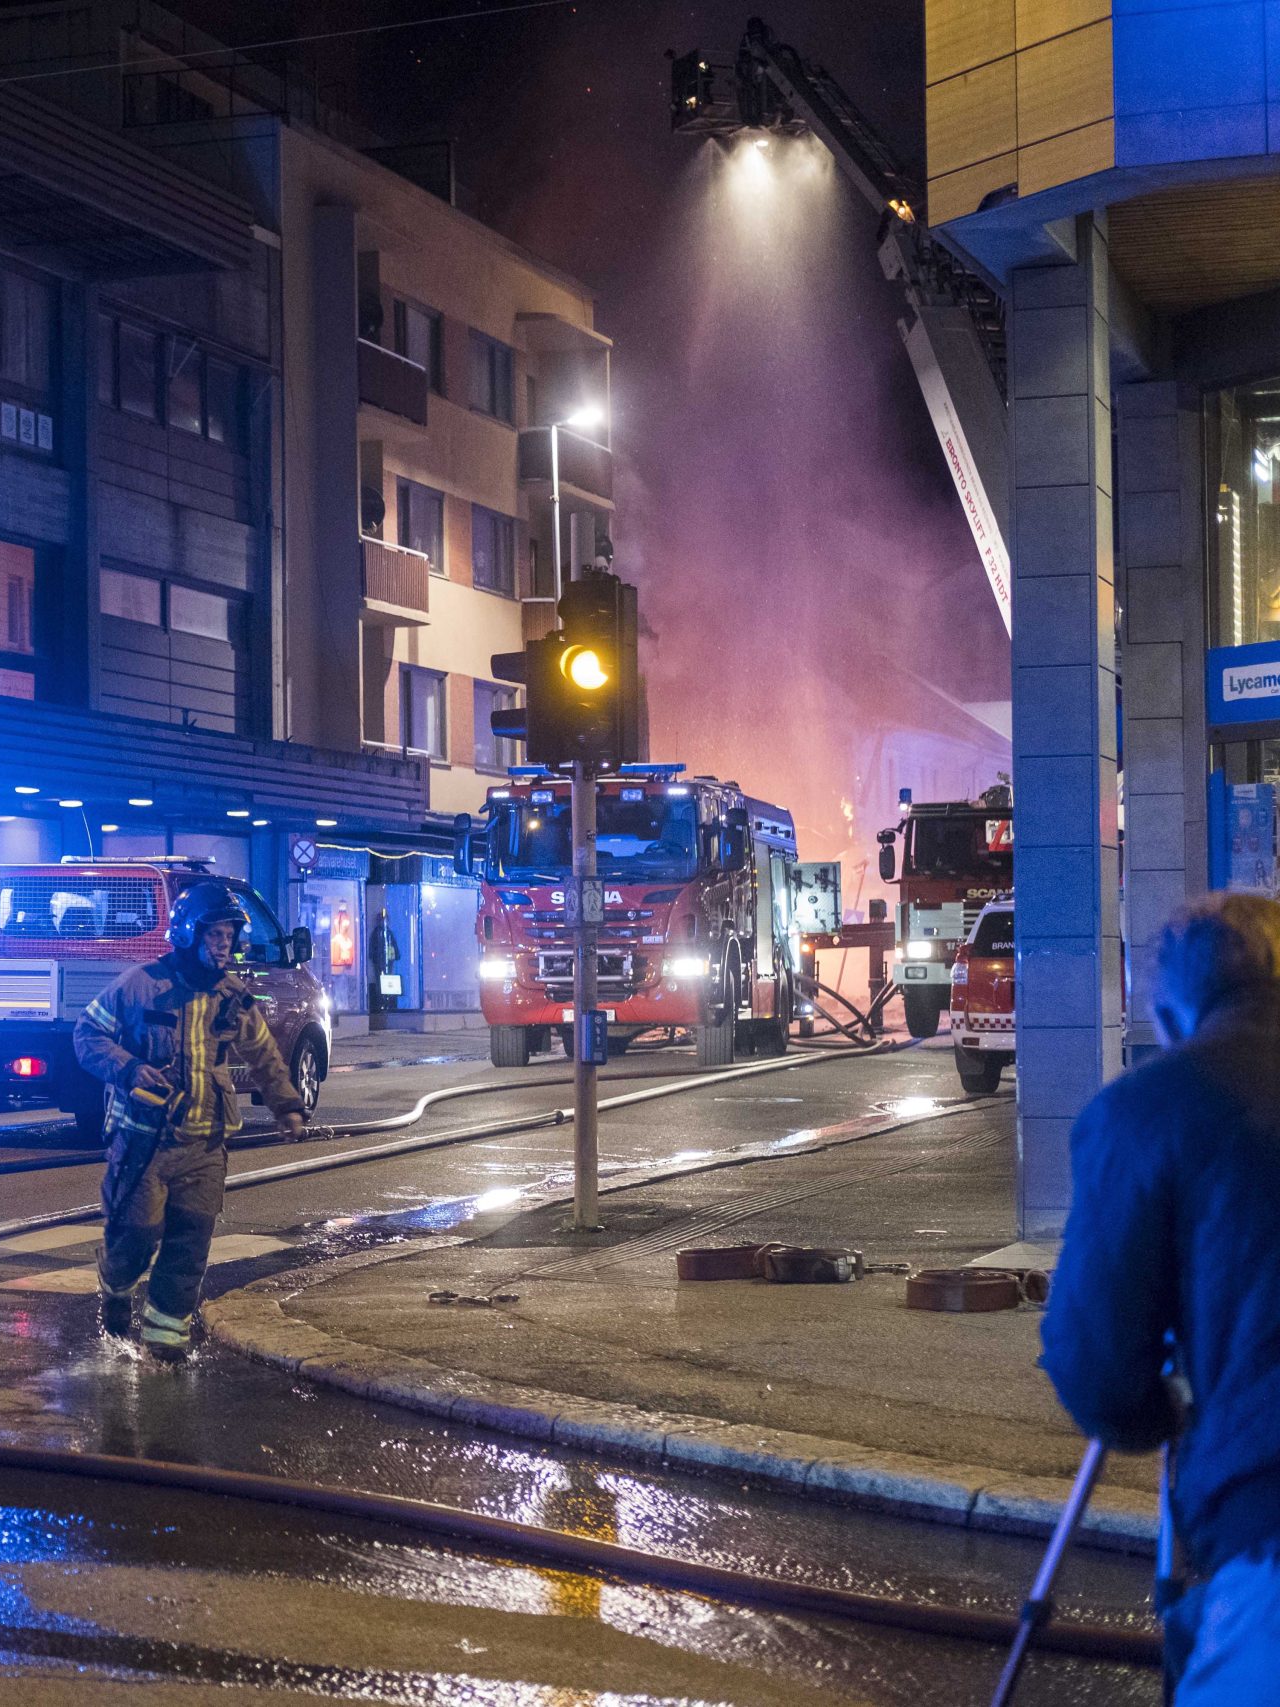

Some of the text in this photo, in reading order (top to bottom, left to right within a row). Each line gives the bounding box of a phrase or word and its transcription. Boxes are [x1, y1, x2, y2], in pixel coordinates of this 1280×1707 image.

[945, 437, 967, 490] BRONTO
[964, 491, 986, 541] SKYLIFT
[994, 575, 1009, 602] HDT
[1229, 674, 1280, 695] Lycam
[551, 891, 624, 904] SIA
